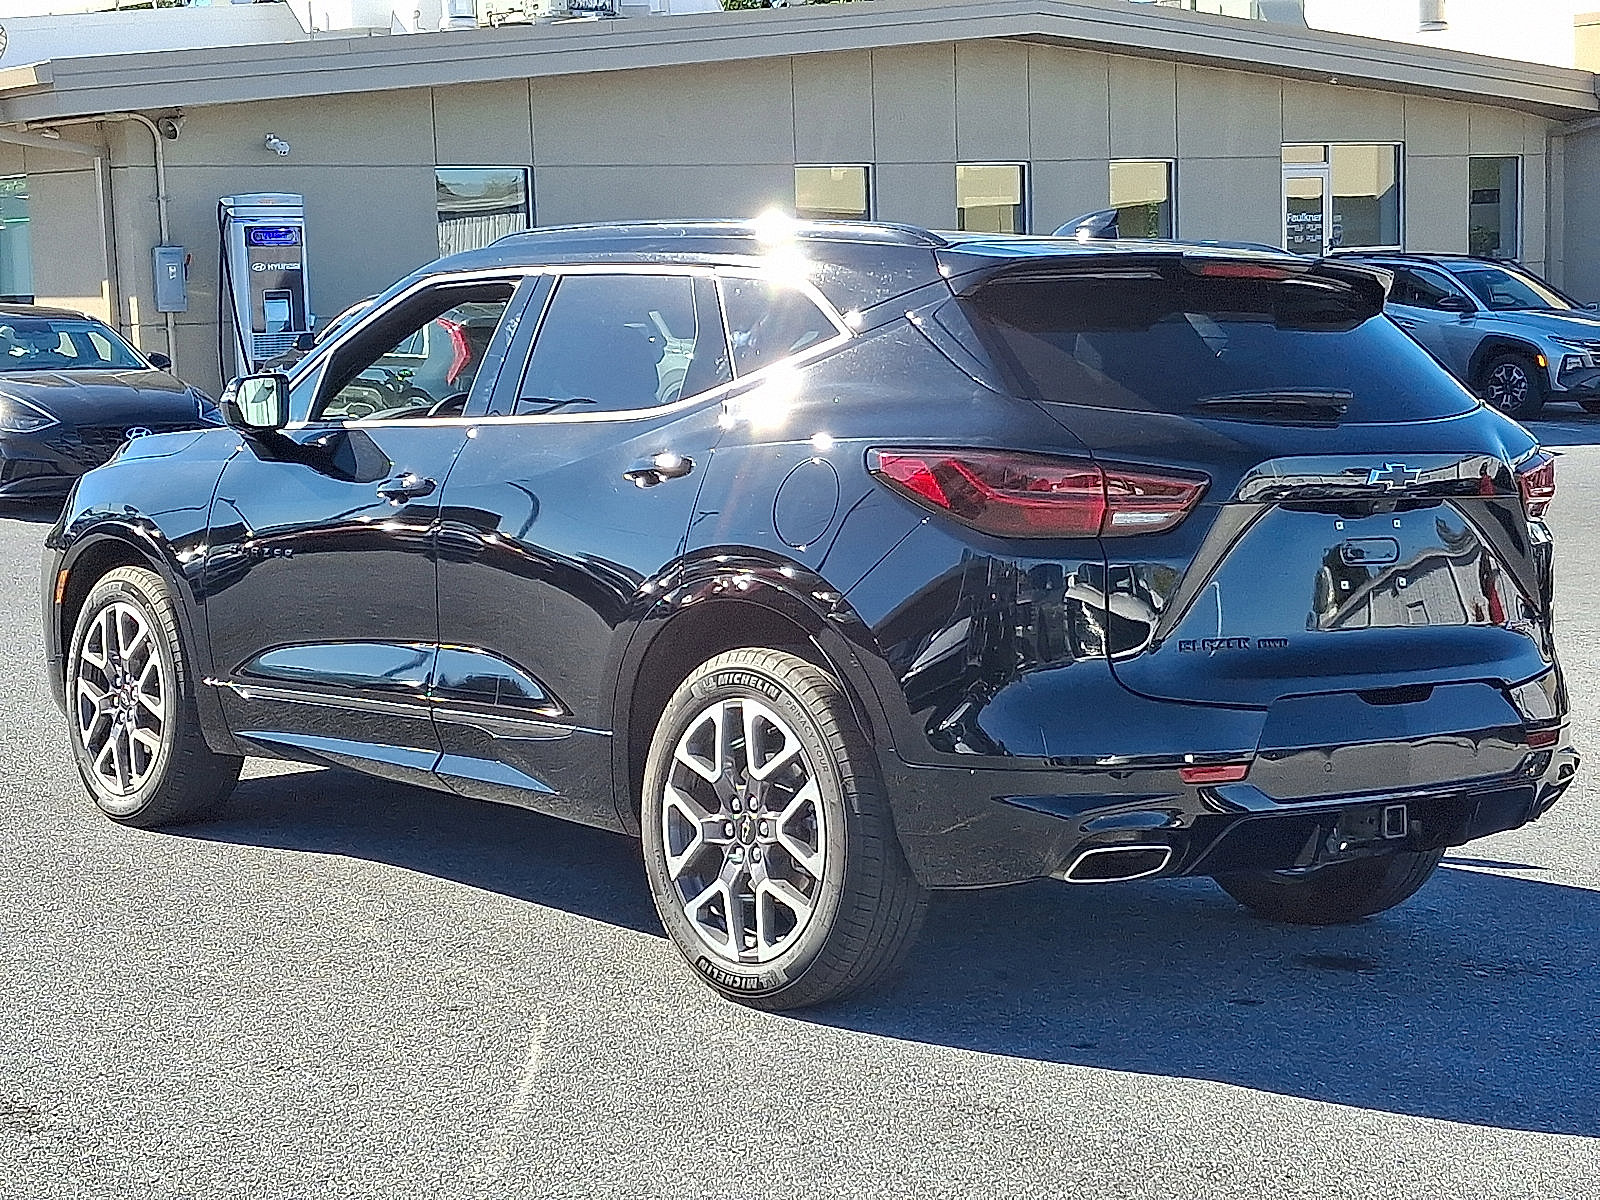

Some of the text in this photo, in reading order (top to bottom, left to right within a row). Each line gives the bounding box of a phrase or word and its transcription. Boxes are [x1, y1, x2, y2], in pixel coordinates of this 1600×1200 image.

[1286, 213, 1322, 222] Faulkner
[717, 673, 780, 699] MICHELIN
[785, 700, 829, 772] PRIMACY TOUR
[698, 958, 758, 989] MICHELIN
